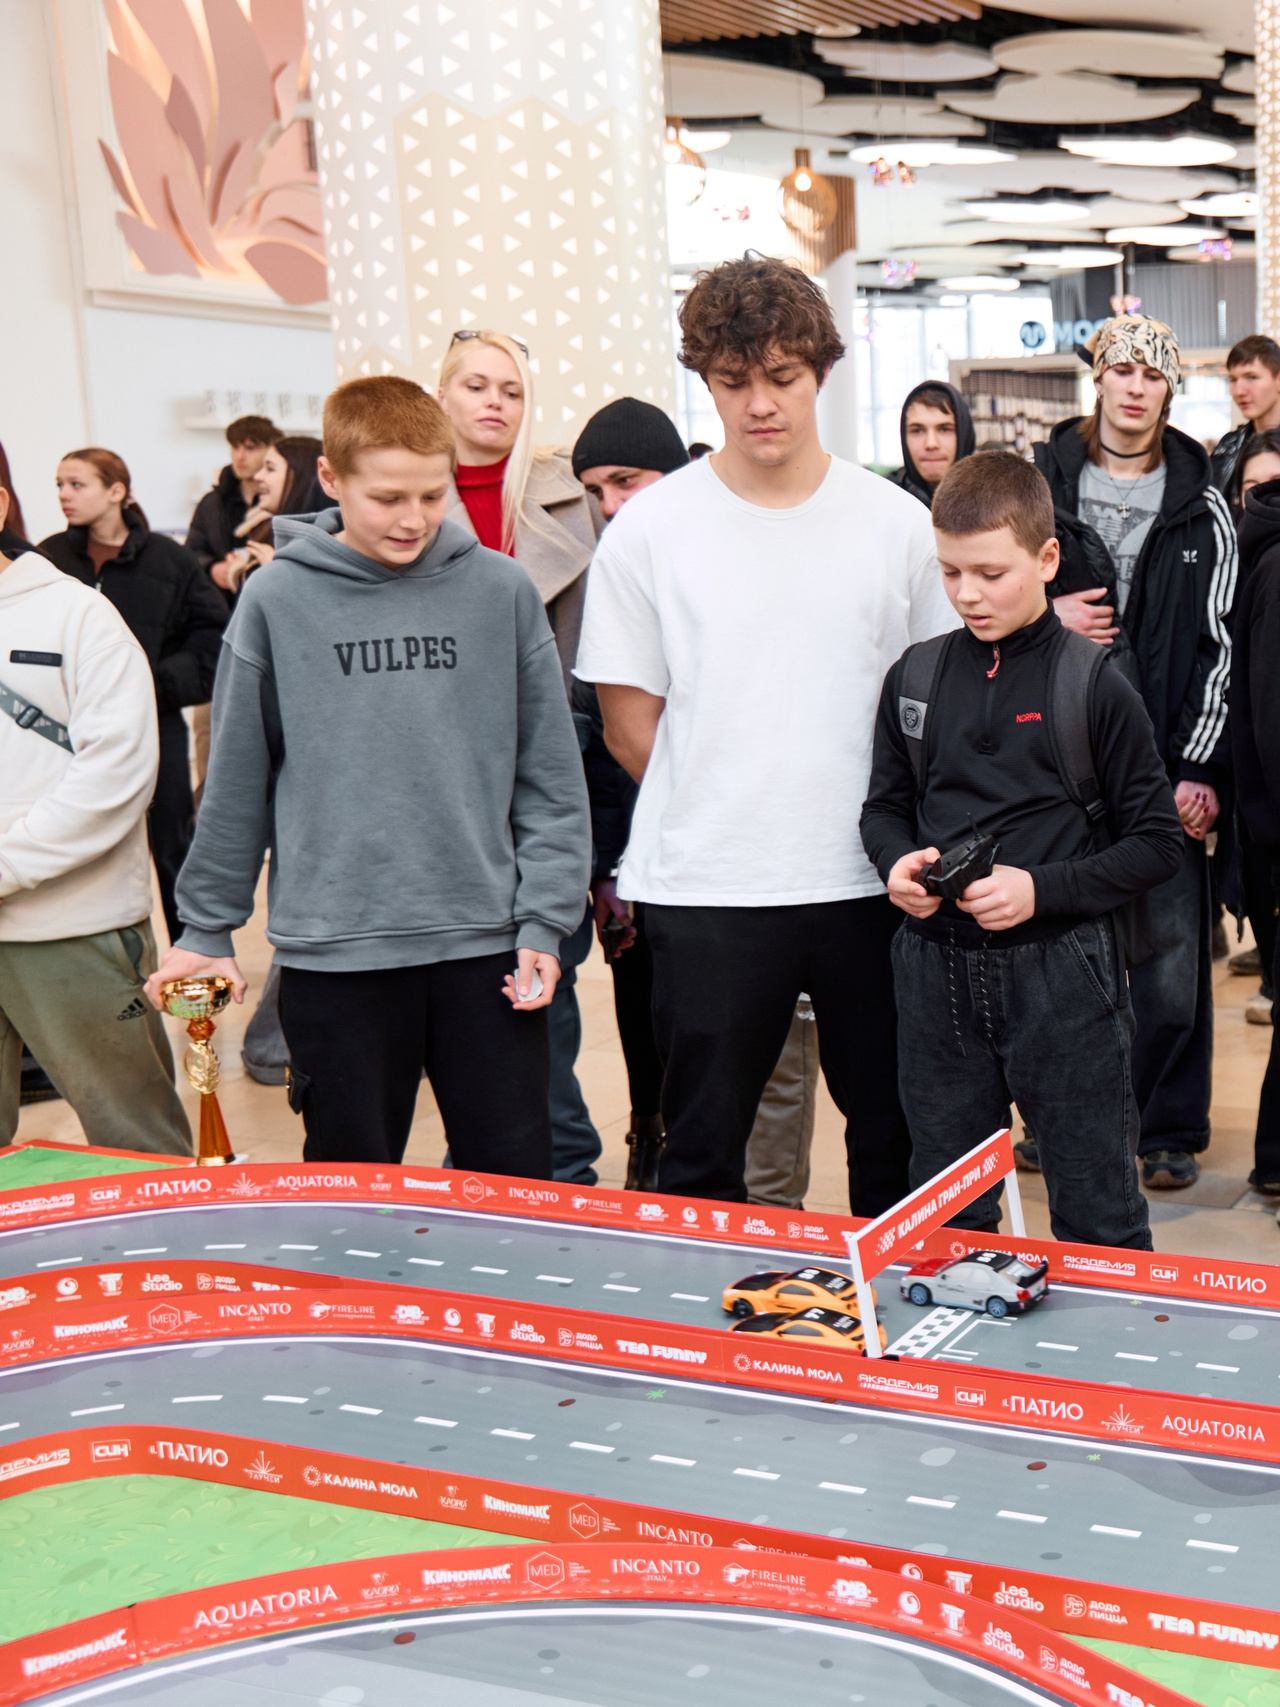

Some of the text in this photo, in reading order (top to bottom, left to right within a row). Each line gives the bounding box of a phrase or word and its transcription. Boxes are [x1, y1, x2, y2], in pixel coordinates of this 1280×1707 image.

[333, 636, 457, 676] VULPES
[1016, 711, 1042, 724] NORPPA
[144, 1179, 211, 1197] ПАТИО
[277, 1175, 358, 1190] AQUATORIA
[509, 1187, 559, 1202] INCANTO
[897, 1165, 981, 1239] КАЛИНА ГРАН-ПРИ
[588, 1199, 622, 1210] FIRELINE
[743, 1224, 776, 1236] Studio
[747, 1217, 765, 1227] Lee
[1063, 1255, 1136, 1271] АКАДЕМИЯ
[141, 1281, 183, 1292] Studio
[146, 1273, 169, 1283] Lee
[1201, 1272, 1266, 1293] ПАТИО
[219, 1302, 291, 1317] INCANTO
[332, 1304, 375, 1314] FIRELINE
[54, 1316, 129, 1338] КИНОМАКС
[152, 1313, 177, 1325] MED
[514, 1321, 534, 1333] Lee
[511, 1329, 545, 1344] Studio
[576, 1333, 597, 1341] ДОДО
[576, 1340, 603, 1350] ПИЦЦА
[617, 1340, 707, 1363] TEA FUNNY
[754, 1360, 803, 1376] КАЛИНА
[859, 1373, 938, 1393] АКАДЕМИЯ
[1010, 1396, 1083, 1420] ПАТИО
[1162, 1415, 1265, 1442] AQUATORIA
[158, 1441, 229, 1467] ПАТИО
[324, 1473, 377, 1491] КАЛИНА
[484, 1494, 550, 1520] КИНОМАКС
[573, 1513, 596, 1528] MED
[637, 1521, 713, 1547] INCANTO
[424, 1564, 511, 1585] КИНОМАКС
[531, 1564, 560, 1577] MED
[613, 1559, 700, 1576] INCANTO
[752, 1569, 806, 1586] FIRELINE
[1000, 1582, 1028, 1597] Lee
[195, 1584, 338, 1629] AQUATORIA
[994, 1592, 1044, 1613] Studio
[1090, 1601, 1120, 1613] ДОДО
[1090, 1610, 1128, 1625] ПИЦЦА
[988, 1622, 1012, 1642] Lee
[1149, 1613, 1279, 1649] TEA FUNNY
[24, 1629, 127, 1675] КИНОМАКС
[984, 1633, 1024, 1660] Studio
[1060, 1657, 1085, 1676] ДОДО
[1060, 1667, 1090, 1689] ПИЦЦА
